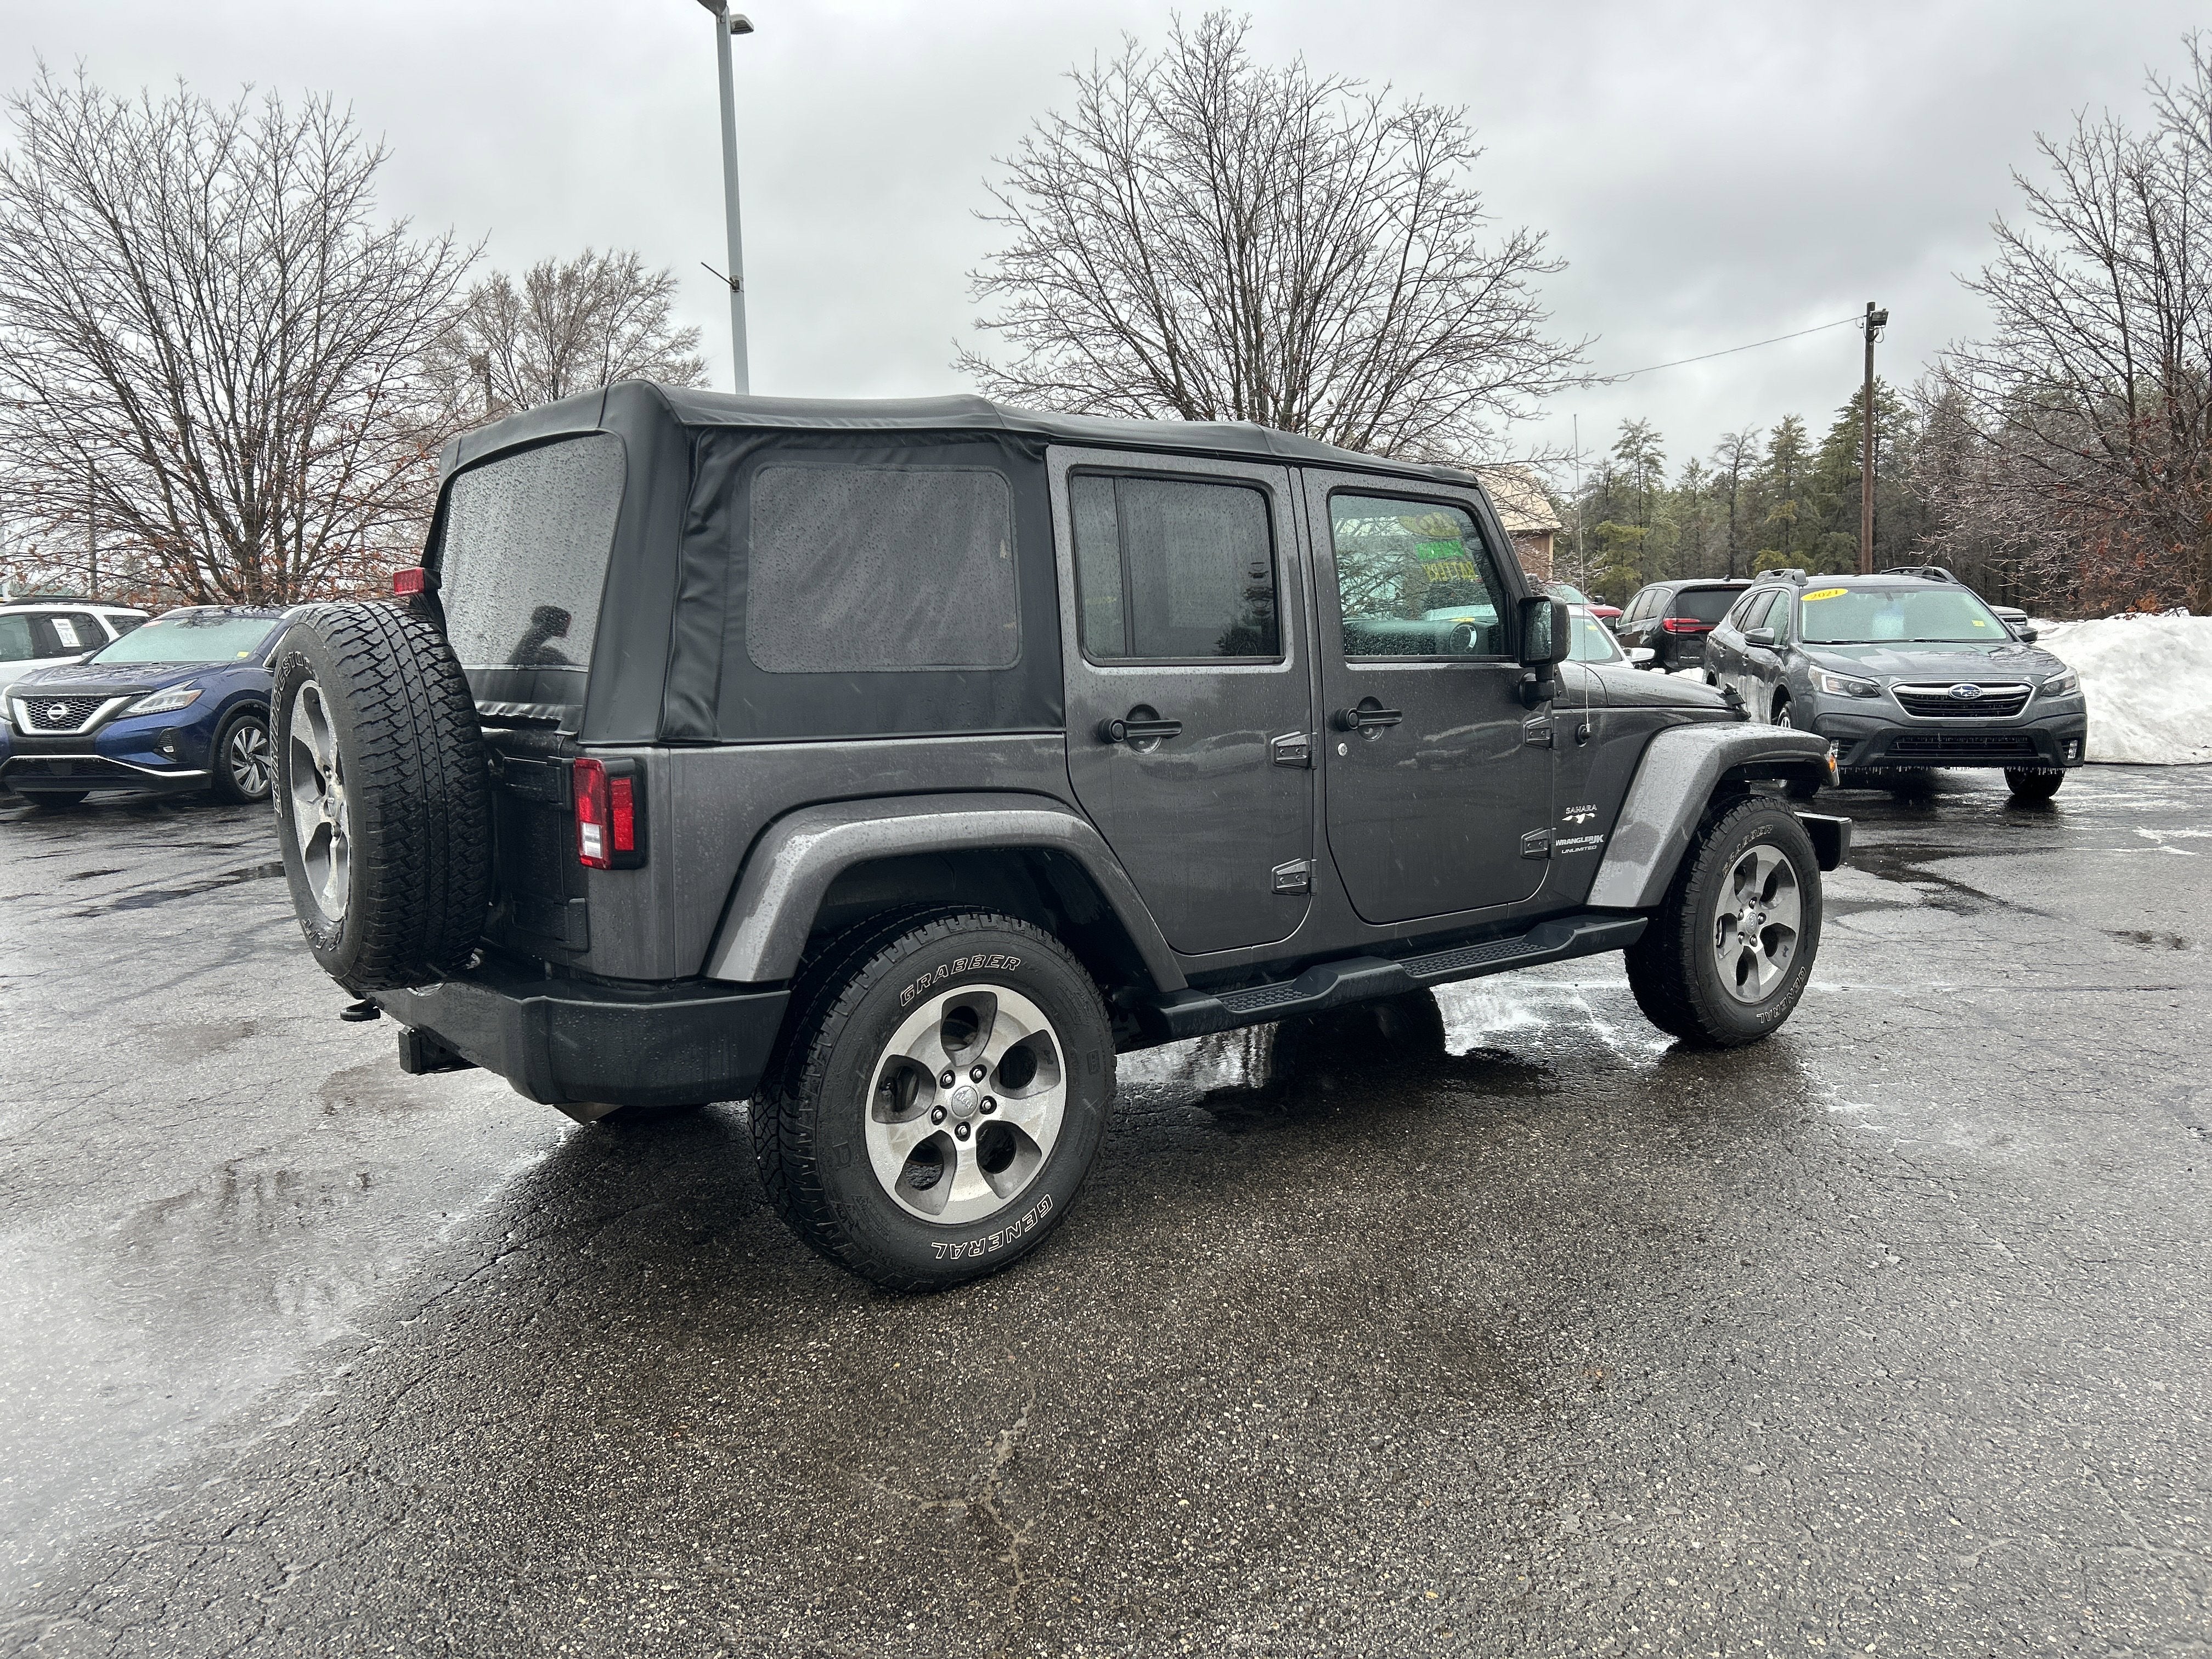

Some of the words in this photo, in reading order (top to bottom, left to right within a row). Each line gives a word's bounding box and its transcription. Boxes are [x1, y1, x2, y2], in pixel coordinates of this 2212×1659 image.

[1810, 590, 1838, 600] 2021
[1565, 804, 1598, 814] SAHARA
[1561, 845, 1597, 854] UNLIMITED
[1722, 824, 1773, 878] GRABBER
[900, 953, 1021, 1007] GRABBER
[1756, 966, 1807, 1024] GENERAL
[931, 1193, 1053, 1260] GENERAL
